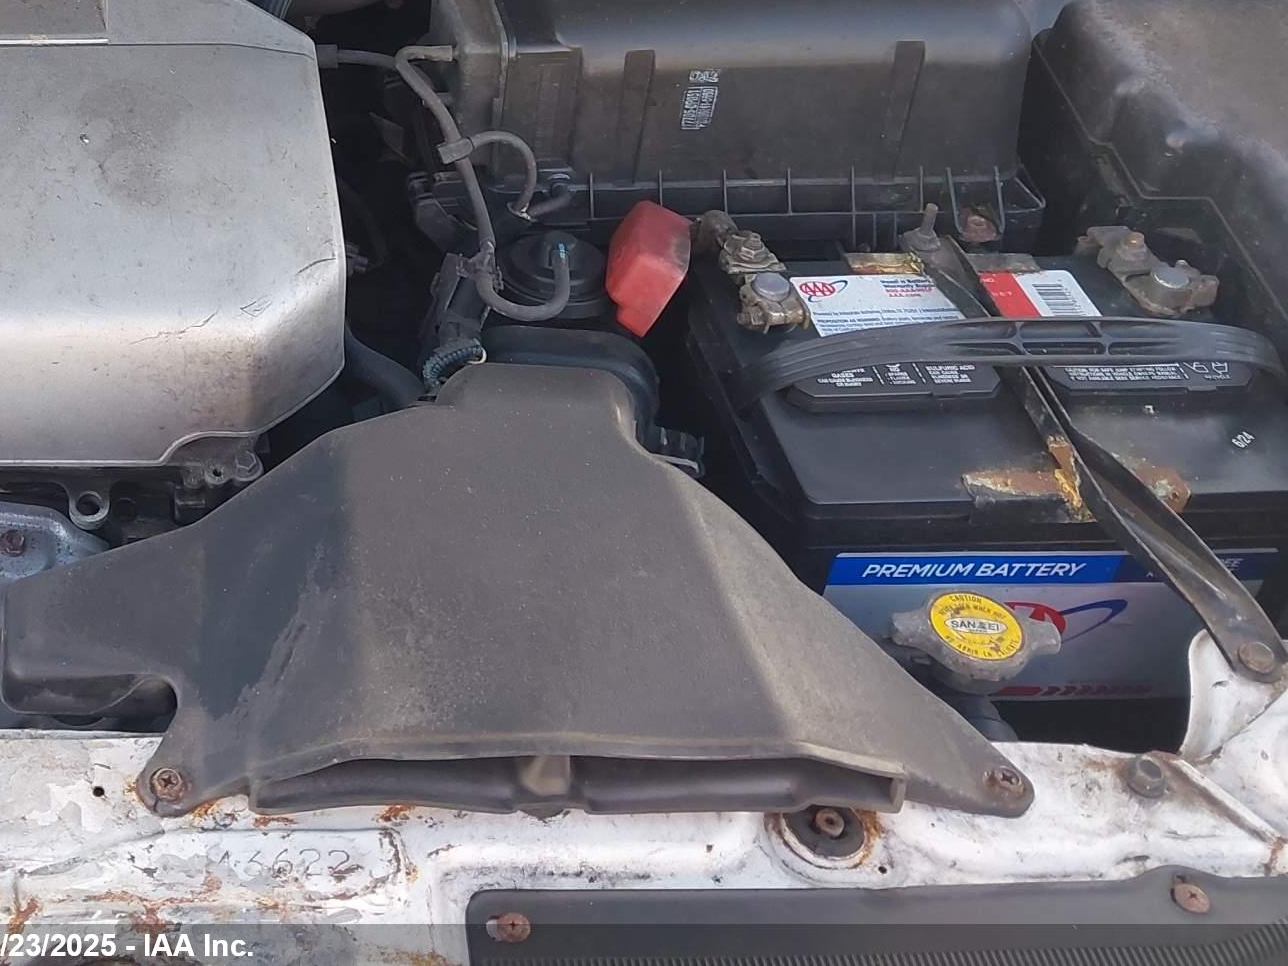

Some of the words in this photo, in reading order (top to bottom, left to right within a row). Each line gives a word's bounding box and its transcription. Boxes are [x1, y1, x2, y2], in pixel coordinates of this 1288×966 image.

[801, 283, 834, 297] AAA
[1232, 431, 1255, 448] 6/24
[862, 563, 973, 578] PREMIUM
[976, 562, 1087, 577] BATTERY
[949, 595, 982, 604] CAUTION
